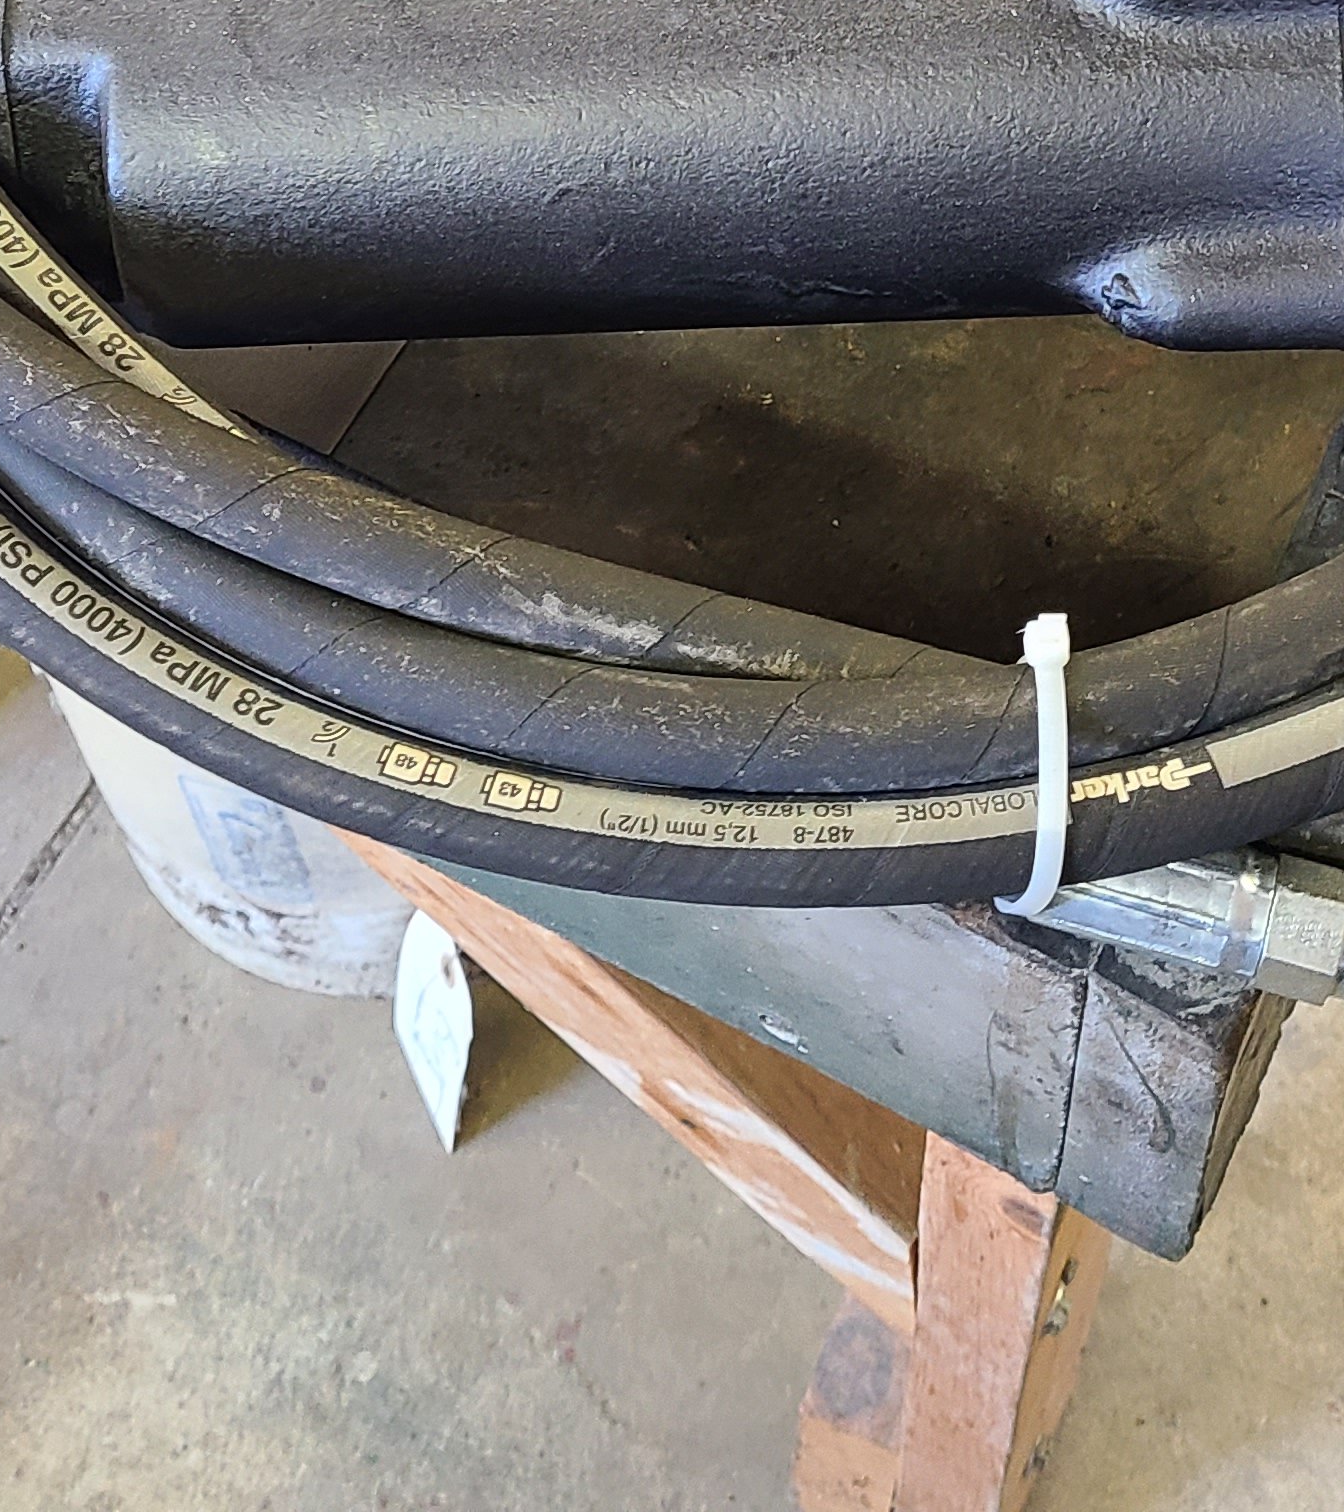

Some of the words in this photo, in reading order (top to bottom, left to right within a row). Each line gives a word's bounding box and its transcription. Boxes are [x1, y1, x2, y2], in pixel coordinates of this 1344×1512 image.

[36, 266, 105, 337] MPa
[97, 331, 147, 373] 28
[50, 579, 147, 656] (4000
[149, 640, 232, 703] MPa
[232, 686, 286, 727] 28
[394, 751, 421, 770] 48
[497, 783, 522, 798] 43
[1070, 757, 1213, 804] Parker
[599, 807, 659, 836] (1/2")
[701, 800, 806, 818] 18752-AC
[812, 802, 853, 818] ISO
[895, 790, 1039, 824] LOBALCORE
[665, 819, 707, 838] mm
[711, 823, 760, 843] 12,5
[792, 825, 855, 844] 487-8
